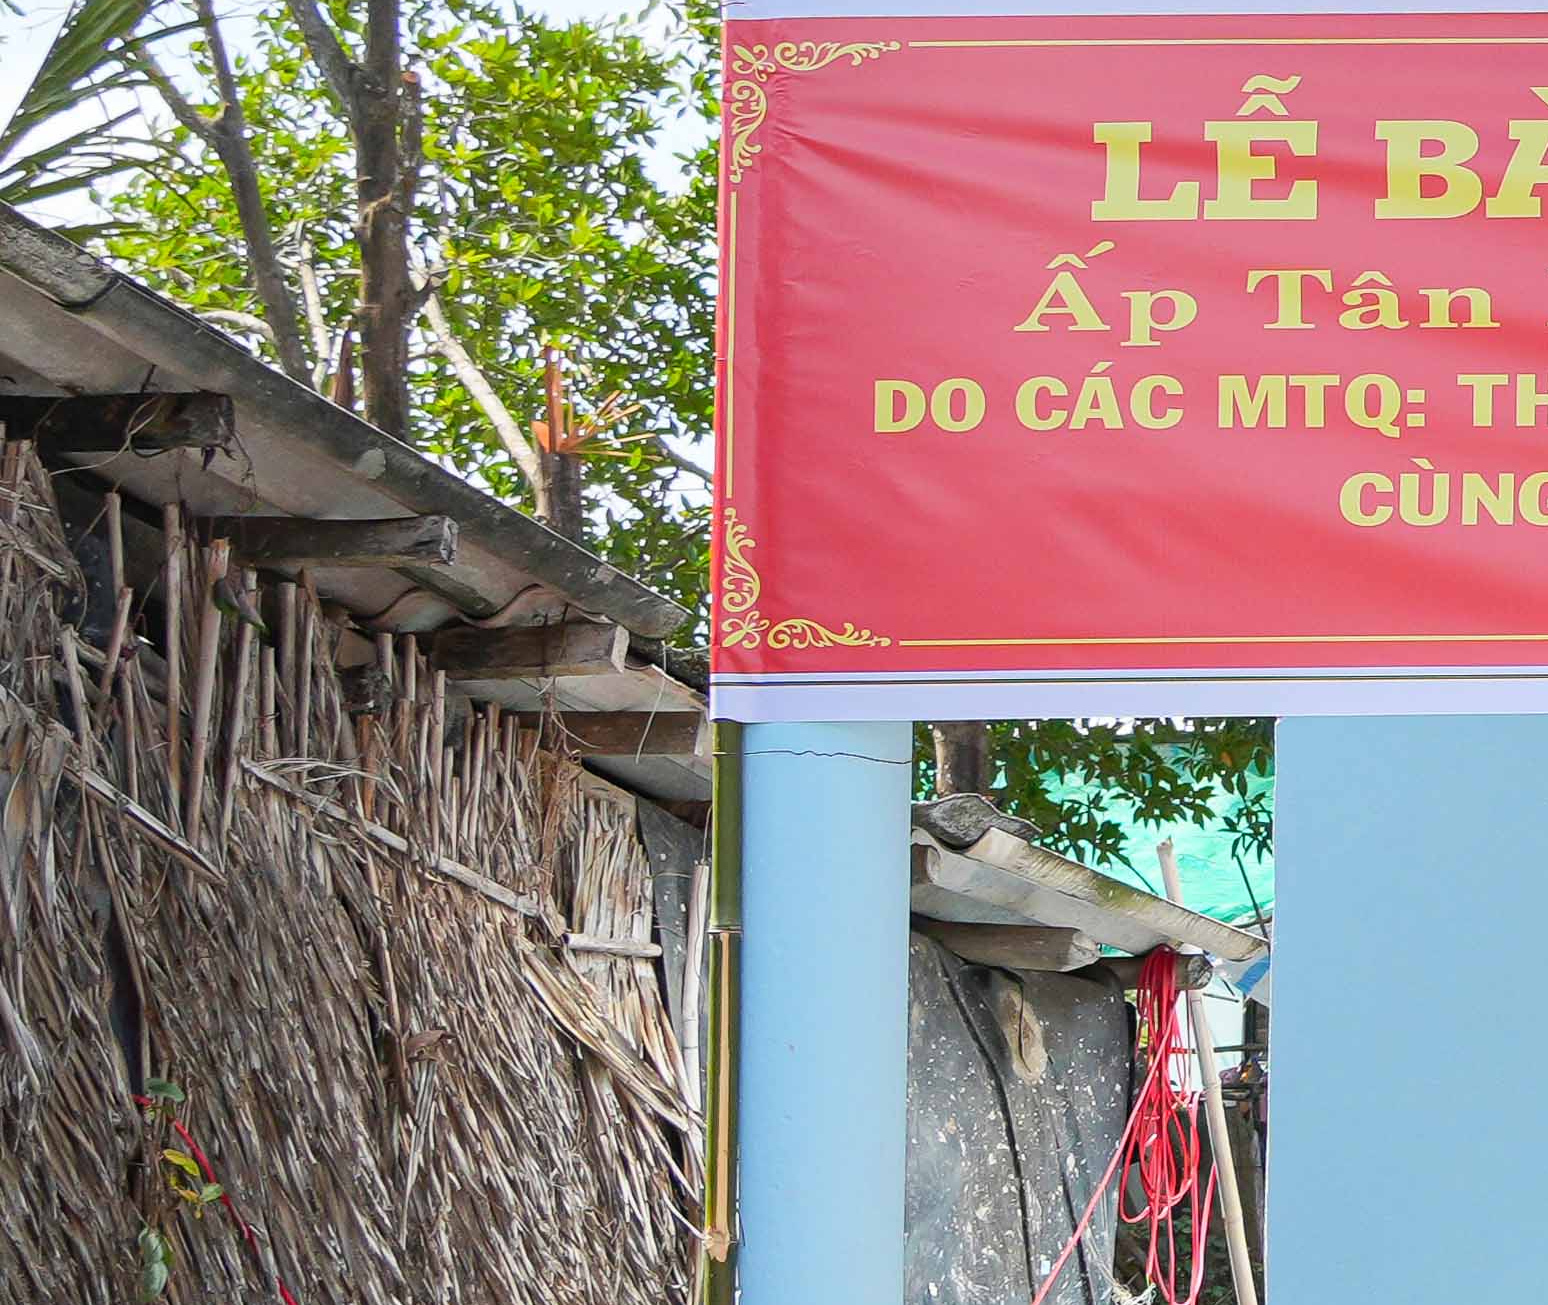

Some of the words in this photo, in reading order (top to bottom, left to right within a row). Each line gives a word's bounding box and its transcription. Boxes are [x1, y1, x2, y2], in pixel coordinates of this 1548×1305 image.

[1091, 73, 1320, 222] LỄ
[1011, 239, 1201, 347] Ấp
[1242, 267, 1504, 330] Tân
[873, 376, 988, 435] DO
[1014, 359, 1186, 431] CÁC
[1217, 371, 1427, 440] MTQ:
